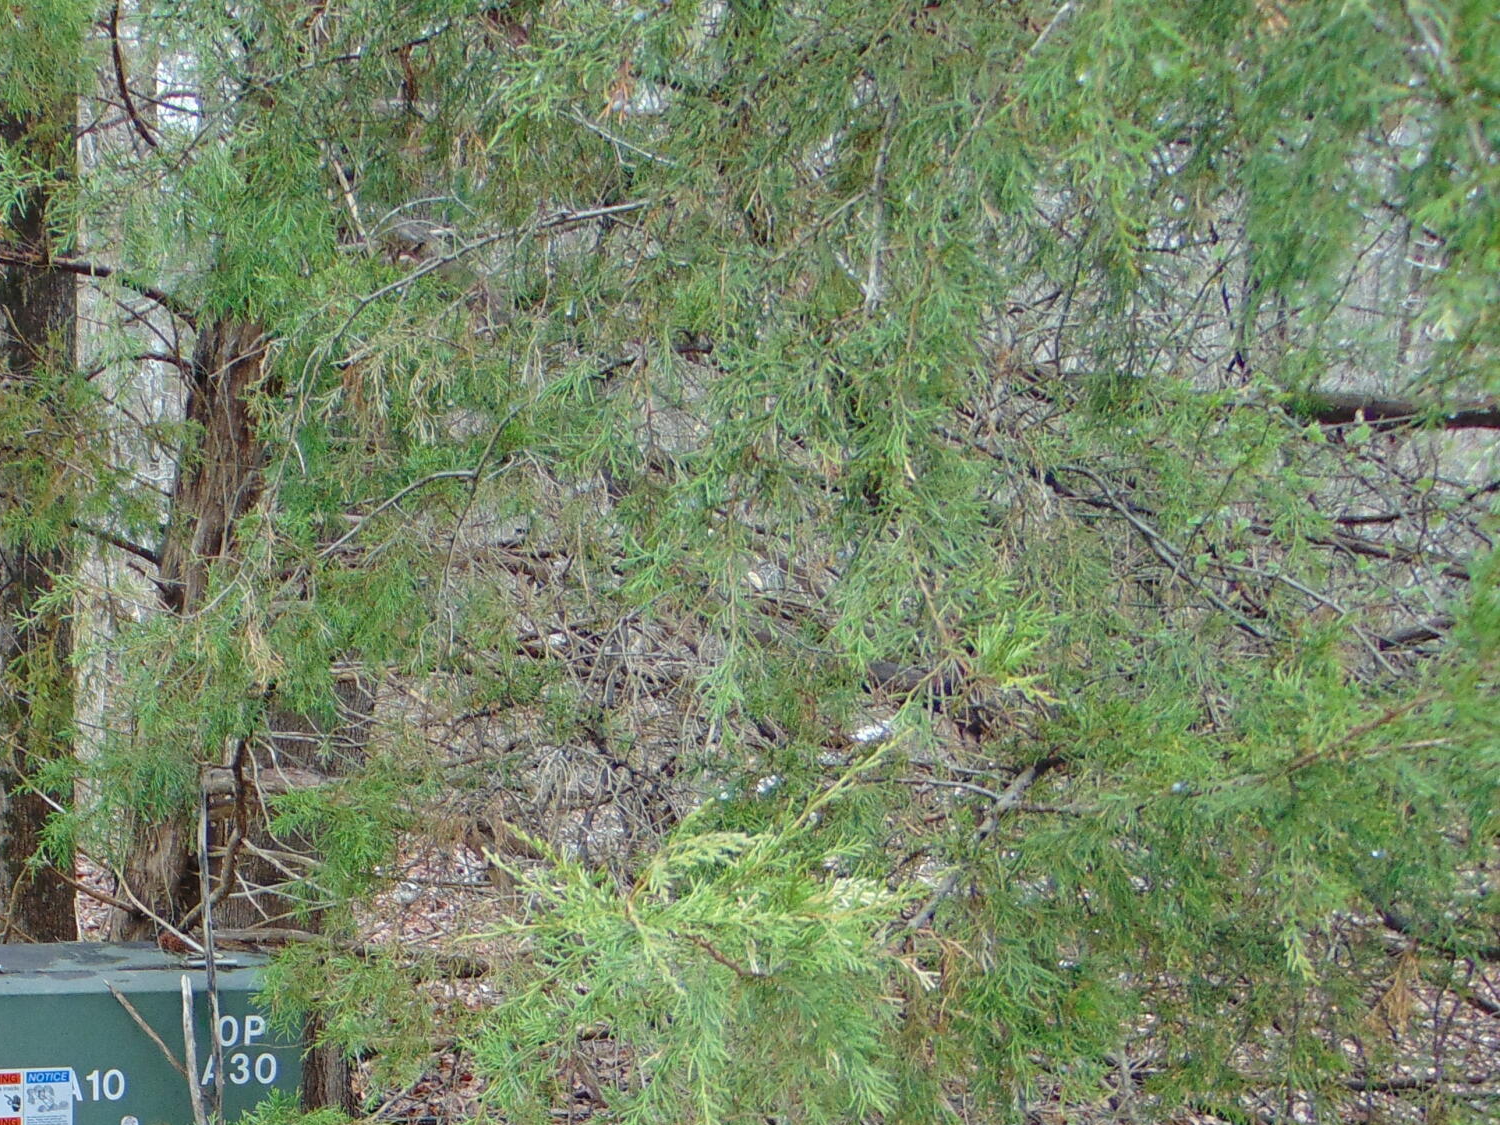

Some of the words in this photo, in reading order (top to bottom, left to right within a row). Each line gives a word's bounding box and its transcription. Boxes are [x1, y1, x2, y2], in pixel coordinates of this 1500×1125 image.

[218, 1015, 266, 1046] OP
[28, 1072, 68, 1083] NOTICE
[201, 1050, 277, 1085] A30
